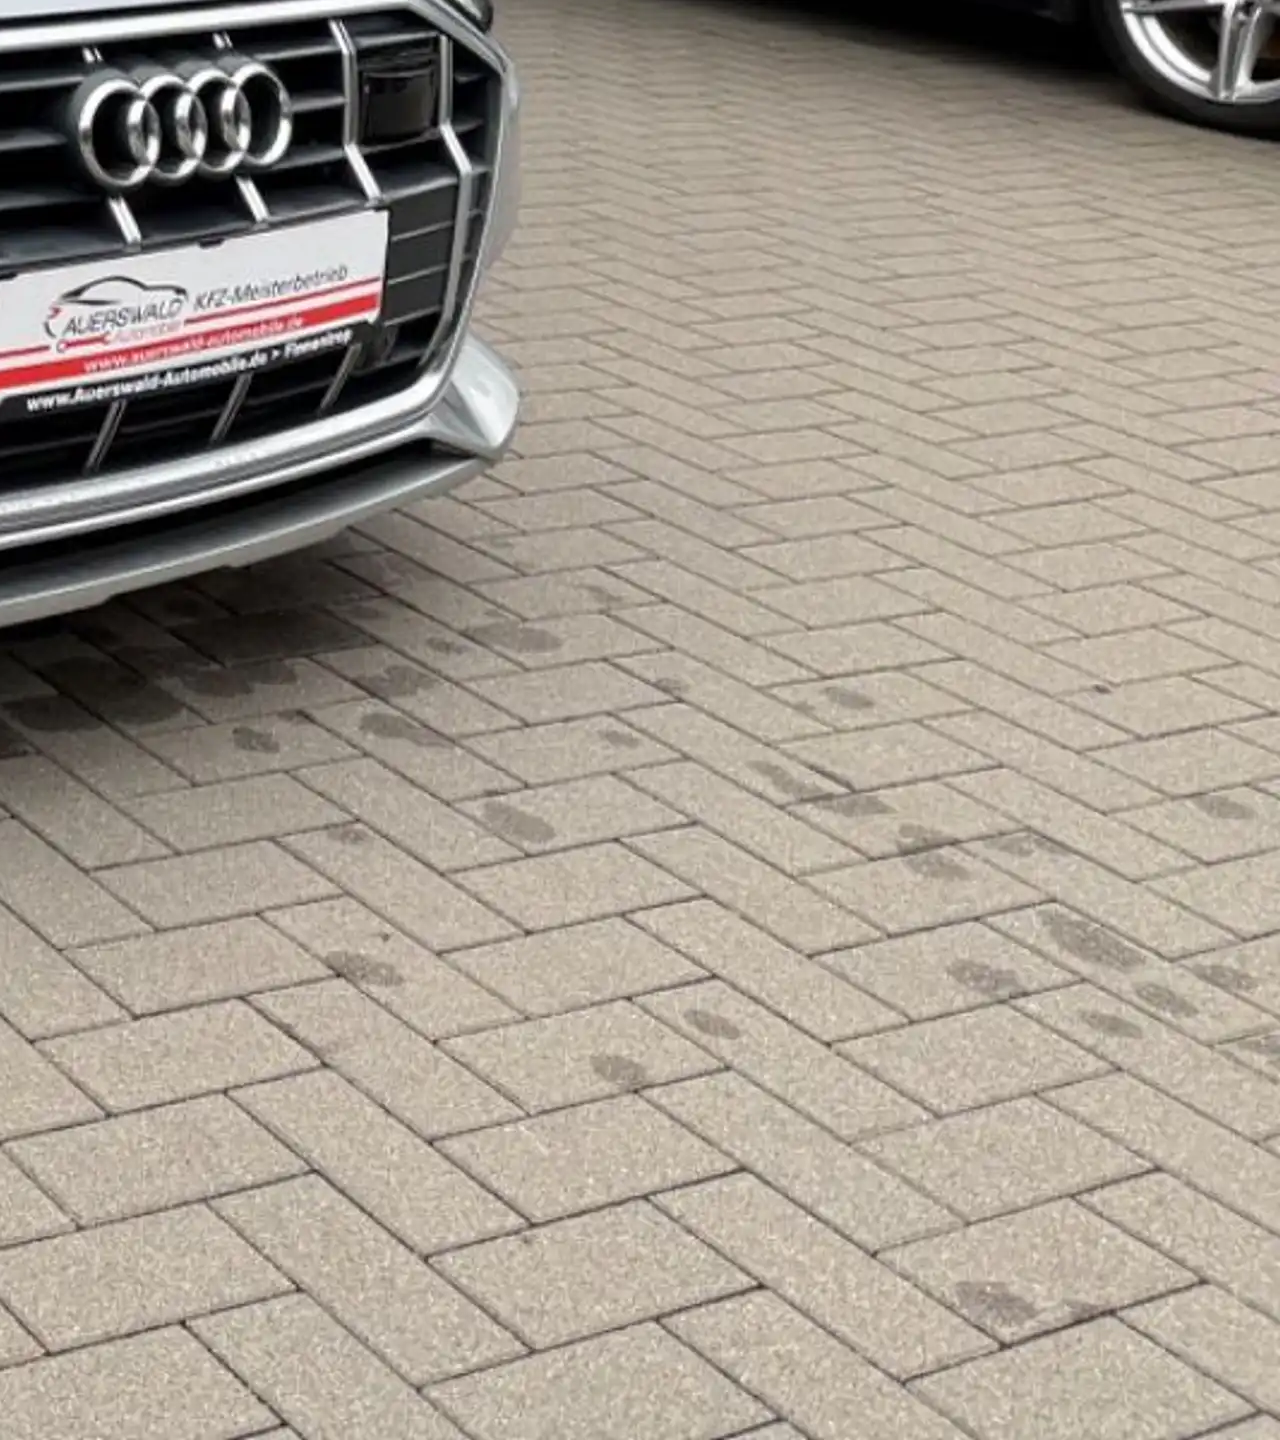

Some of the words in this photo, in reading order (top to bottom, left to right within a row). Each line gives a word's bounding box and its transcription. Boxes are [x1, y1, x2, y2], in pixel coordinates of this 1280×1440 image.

[194, 264, 348, 310] KFZ-Meisterbetrieb
[63, 297, 183, 336] AUERSWALD
[26, 351, 268, 412] www.Auerswald-Automobile.de
